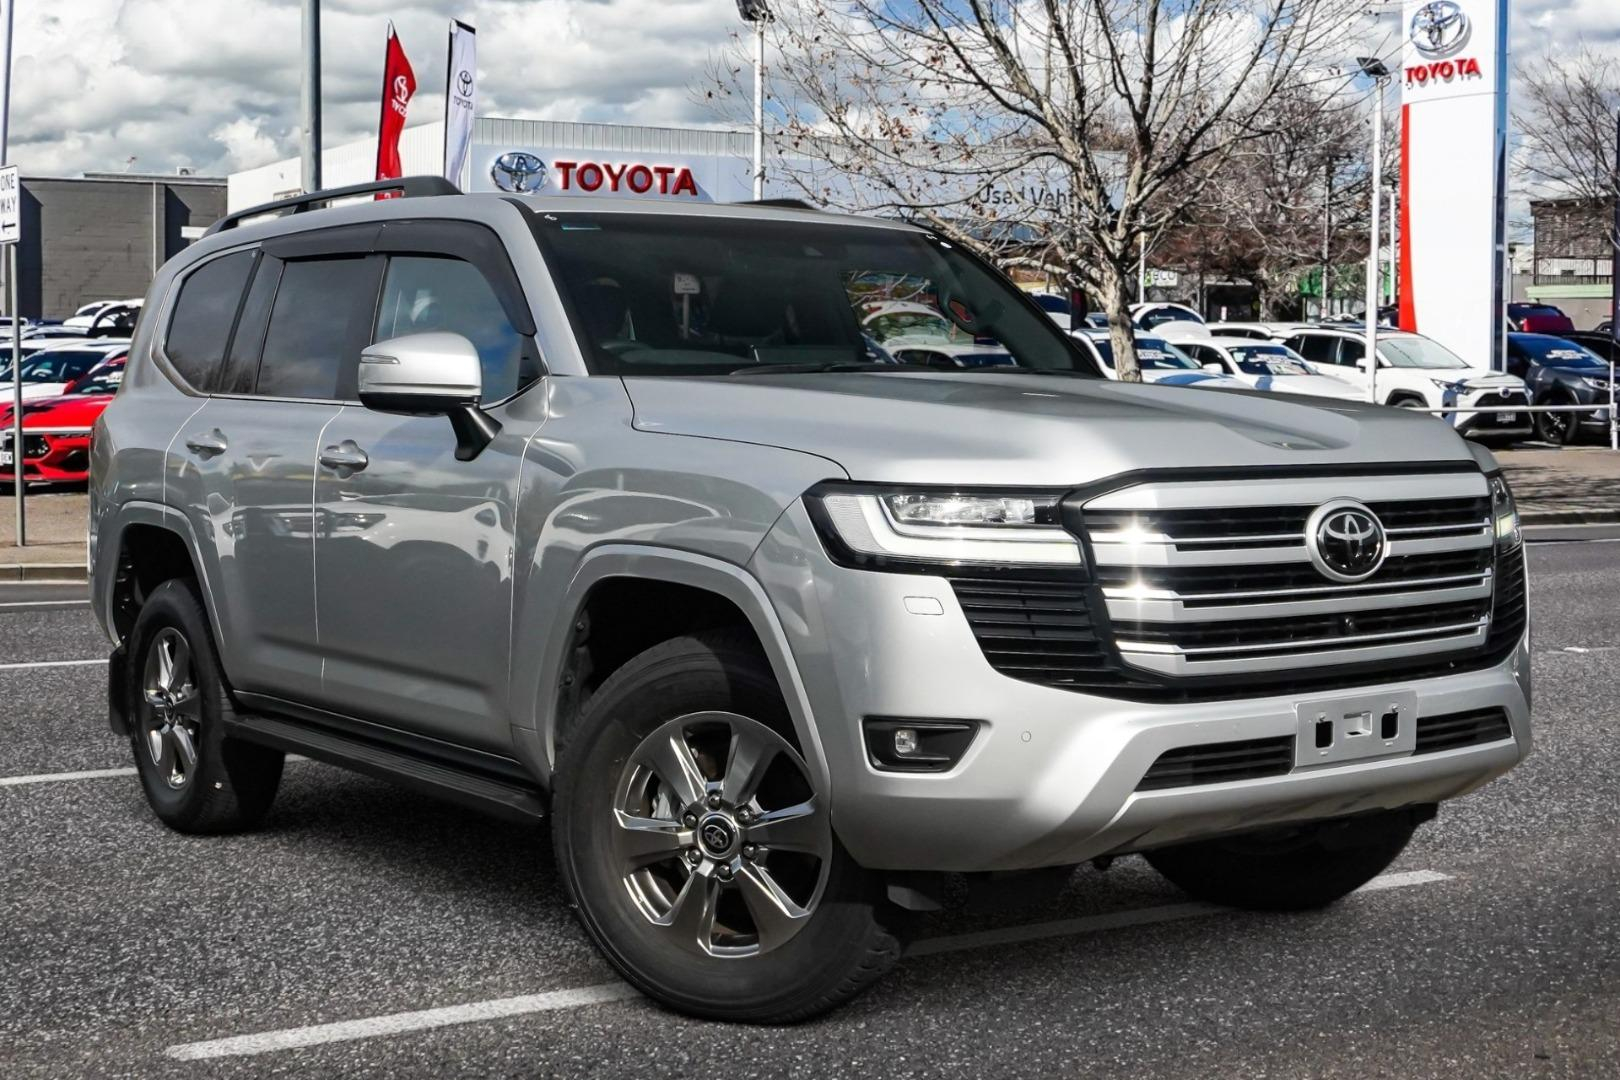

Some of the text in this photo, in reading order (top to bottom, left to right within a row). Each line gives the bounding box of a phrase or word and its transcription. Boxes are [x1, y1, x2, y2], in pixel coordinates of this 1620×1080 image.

[1404, 58, 1481, 83] TOYOTA
[1, 173, 15, 191] ONE
[554, 161, 699, 196] TOYOTA
[1, 196, 16, 213] WAY
